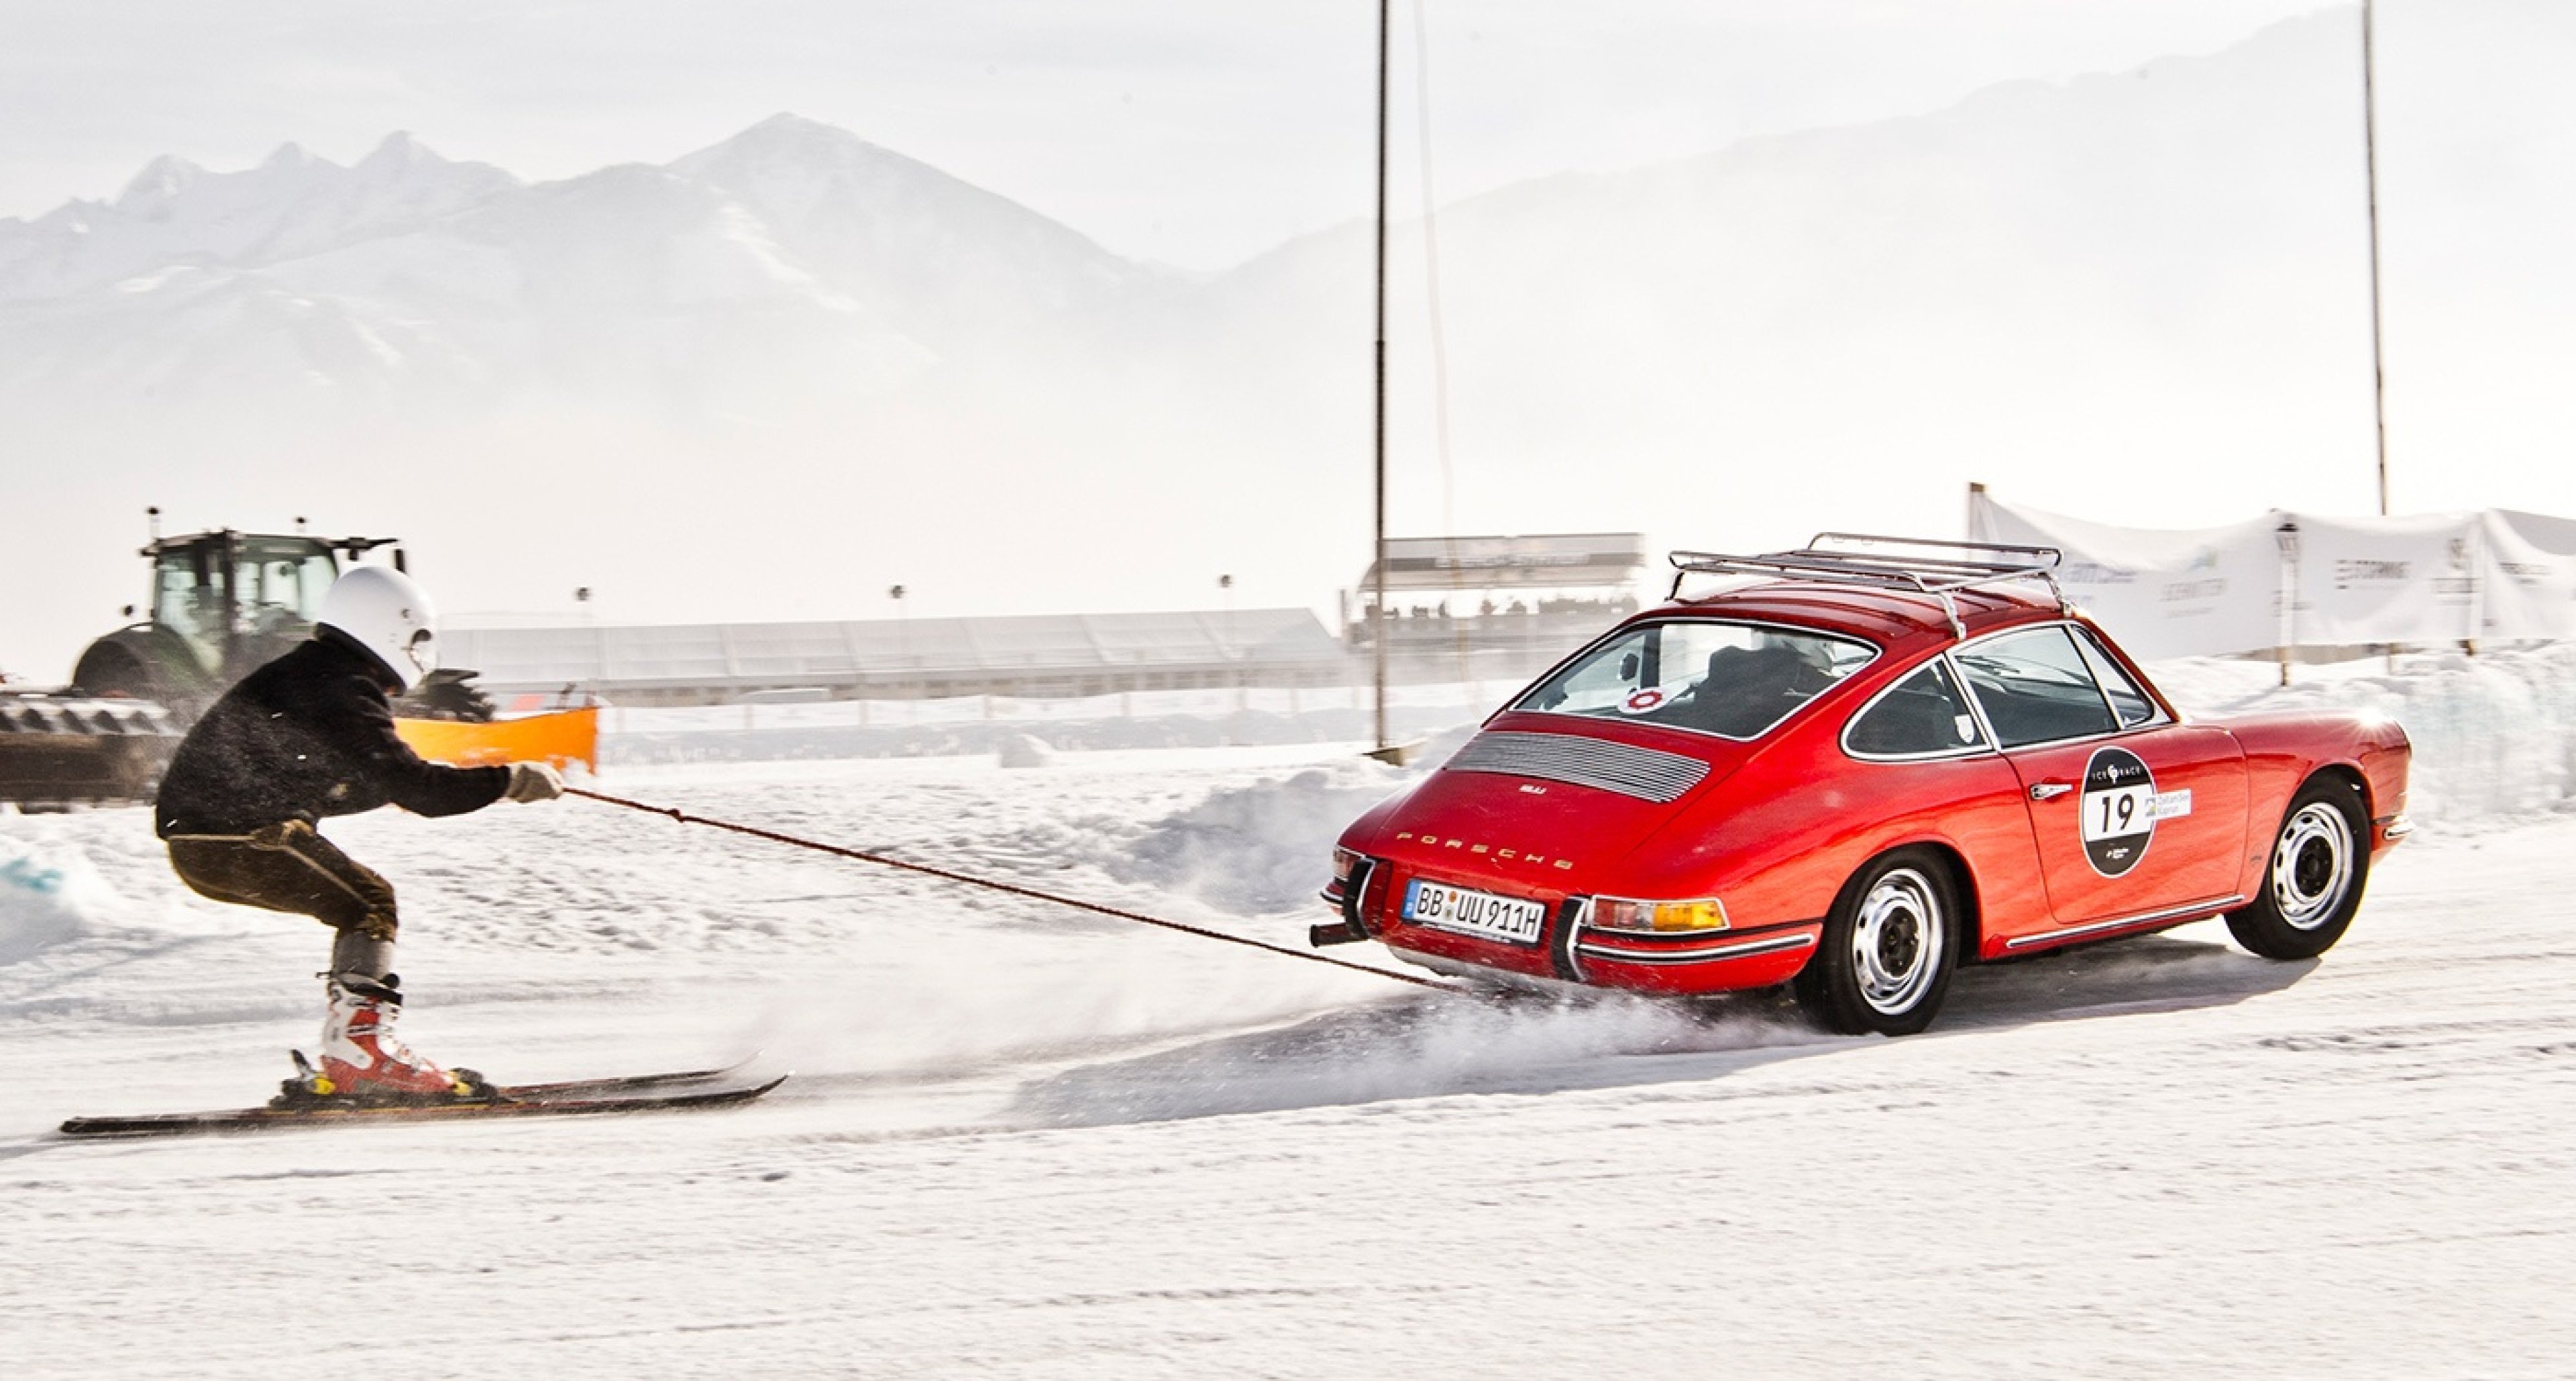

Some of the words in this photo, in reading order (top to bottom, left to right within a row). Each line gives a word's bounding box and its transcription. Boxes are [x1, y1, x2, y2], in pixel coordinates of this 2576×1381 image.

[2102, 793, 2135, 833] 19
[1396, 831, 1573, 870] PORSCHE
[1417, 886, 1444, 916] BB
[1456, 894, 1487, 925] UU
[1485, 900, 1540, 936] 911H
